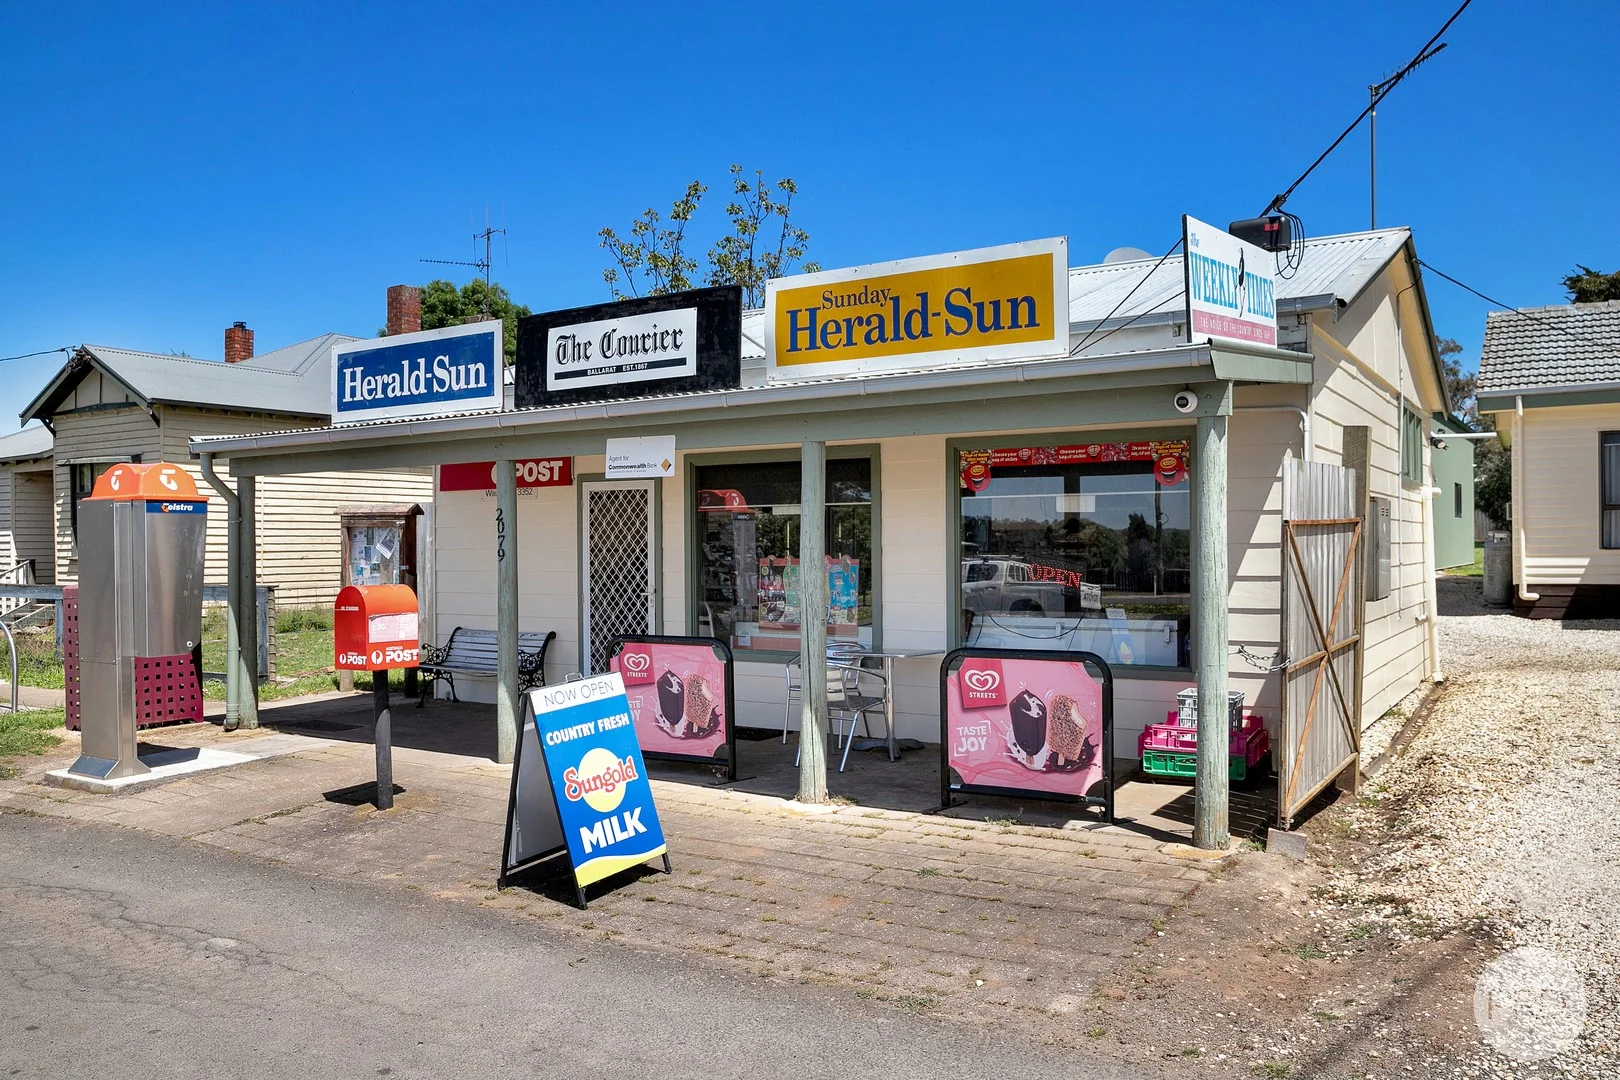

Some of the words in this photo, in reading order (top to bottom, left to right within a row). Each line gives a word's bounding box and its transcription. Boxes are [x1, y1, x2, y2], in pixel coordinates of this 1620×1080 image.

[820, 282, 893, 310] Sunday
[1189, 251, 1239, 310] WEEKLY
[1245, 271, 1275, 319] TIMES
[786, 286, 1041, 353] Herald-Sun
[555, 333, 592, 366] The
[598, 323, 684, 359] Courier
[342, 355, 487, 403] Herald-Sun
[587, 366, 617, 376] BALLARAT
[517, 488, 533, 496] 3352
[161, 502, 194, 513] Telstra
[495, 507, 506, 562] 2079
[1028, 563, 1083, 588] OPEN
[347, 655, 367, 665] POST
[385, 648, 419, 664] POST
[544, 689, 577, 708] NOW
[580, 680, 614, 700] OPEN
[628, 700, 641, 709] STE
[969, 691, 997, 700] STREETS
[545, 720, 596, 747] COUNTRY
[597, 712, 631, 733] FRESH
[957, 725, 988, 736] TASTE
[957, 736, 988, 753] JOY
[563, 755, 638, 802] Sungold
[579, 806, 647, 855] MILK
